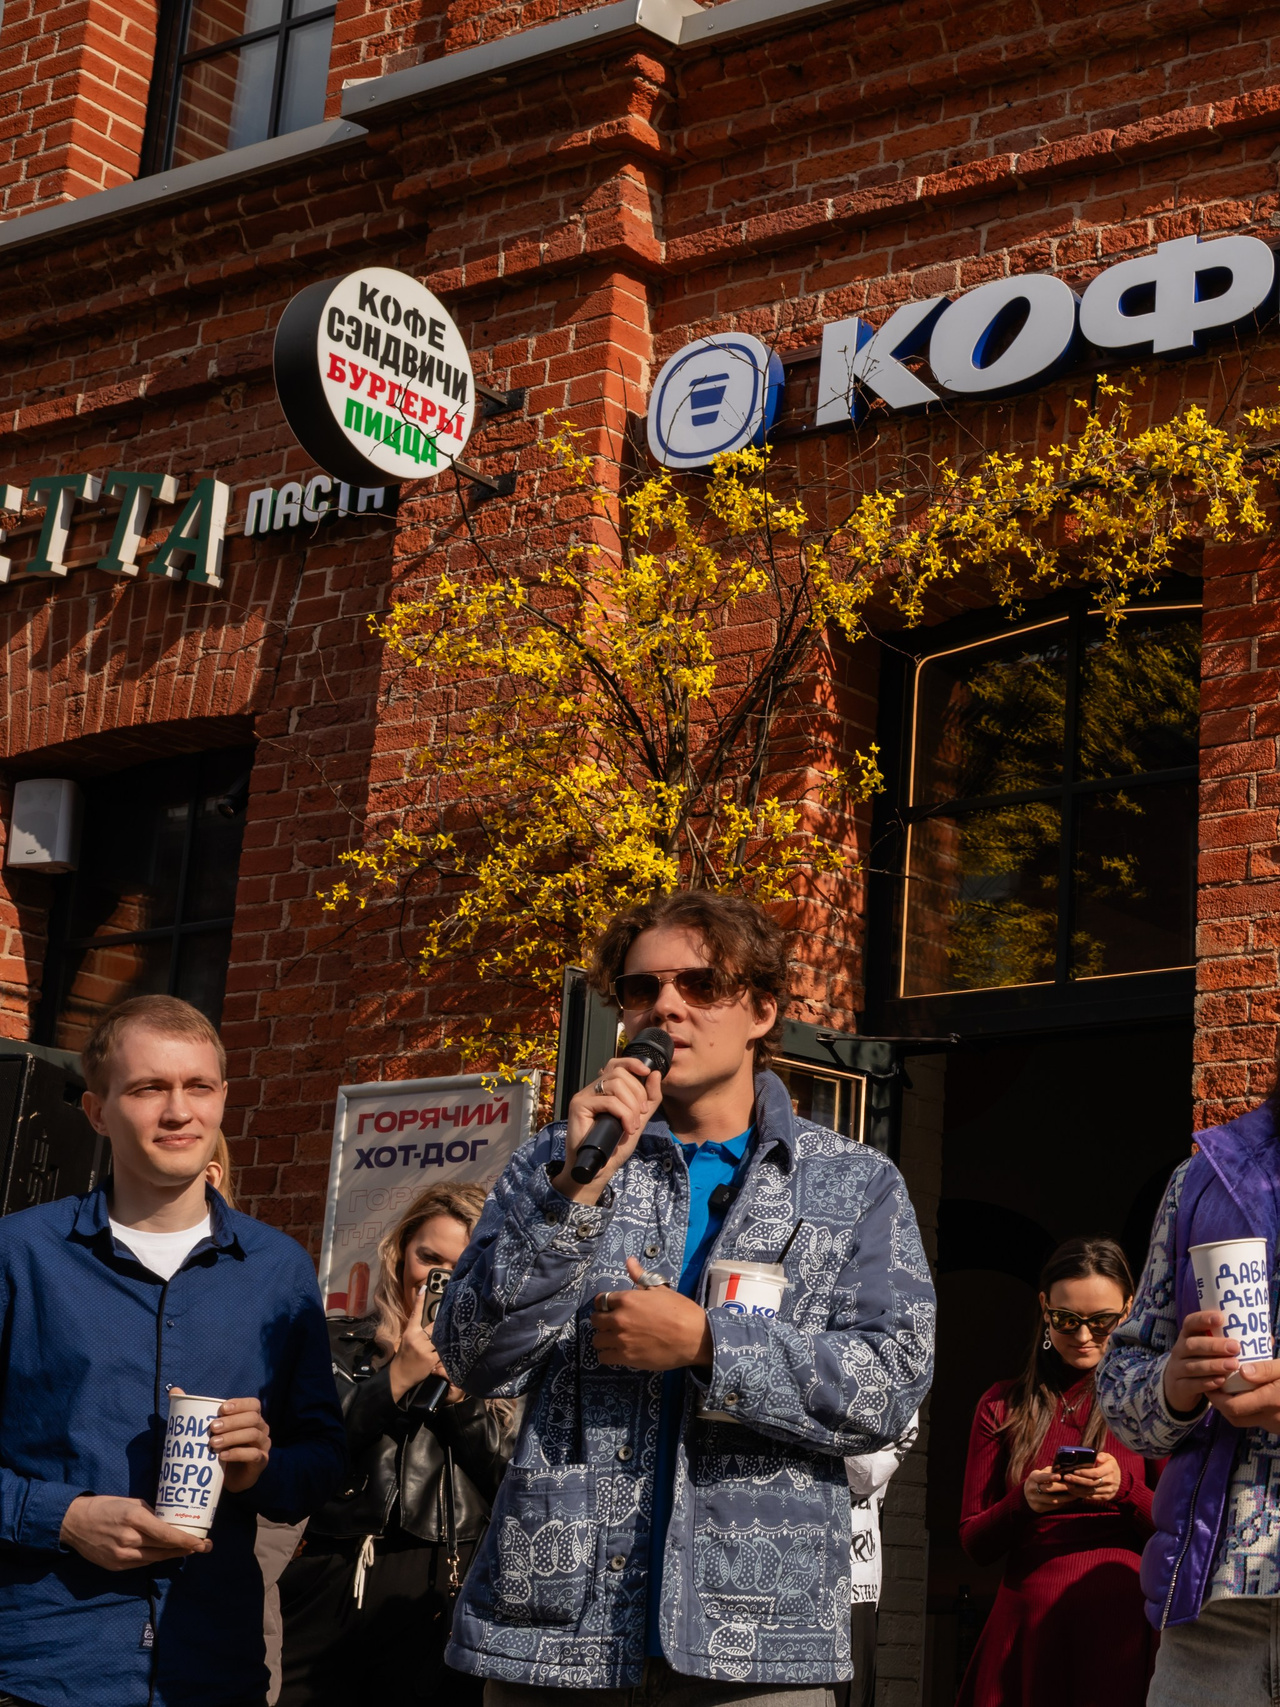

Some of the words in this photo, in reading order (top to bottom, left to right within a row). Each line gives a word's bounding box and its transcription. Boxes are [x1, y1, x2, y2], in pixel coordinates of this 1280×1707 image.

[358, 281, 446, 352] КОФЕ
[327, 306, 468, 405] СЭНДВИЧИ
[327, 352, 465, 441] БУРГЕРЫ
[344, 397, 438, 467] ПИЦЦА
[0, 471, 224, 589] ТТА
[357, 1097, 510, 1135] ГОРЯЧИЙ
[353, 1139, 489, 1170] ХОТ-ДОГ
[1215, 1260, 1268, 1290] ДАВА
[1219, 1288, 1269, 1311] ДЕЛА
[166, 1415, 219, 1438] АВАЙ
[162, 1439, 218, 1462] ЕЛАТЬ
